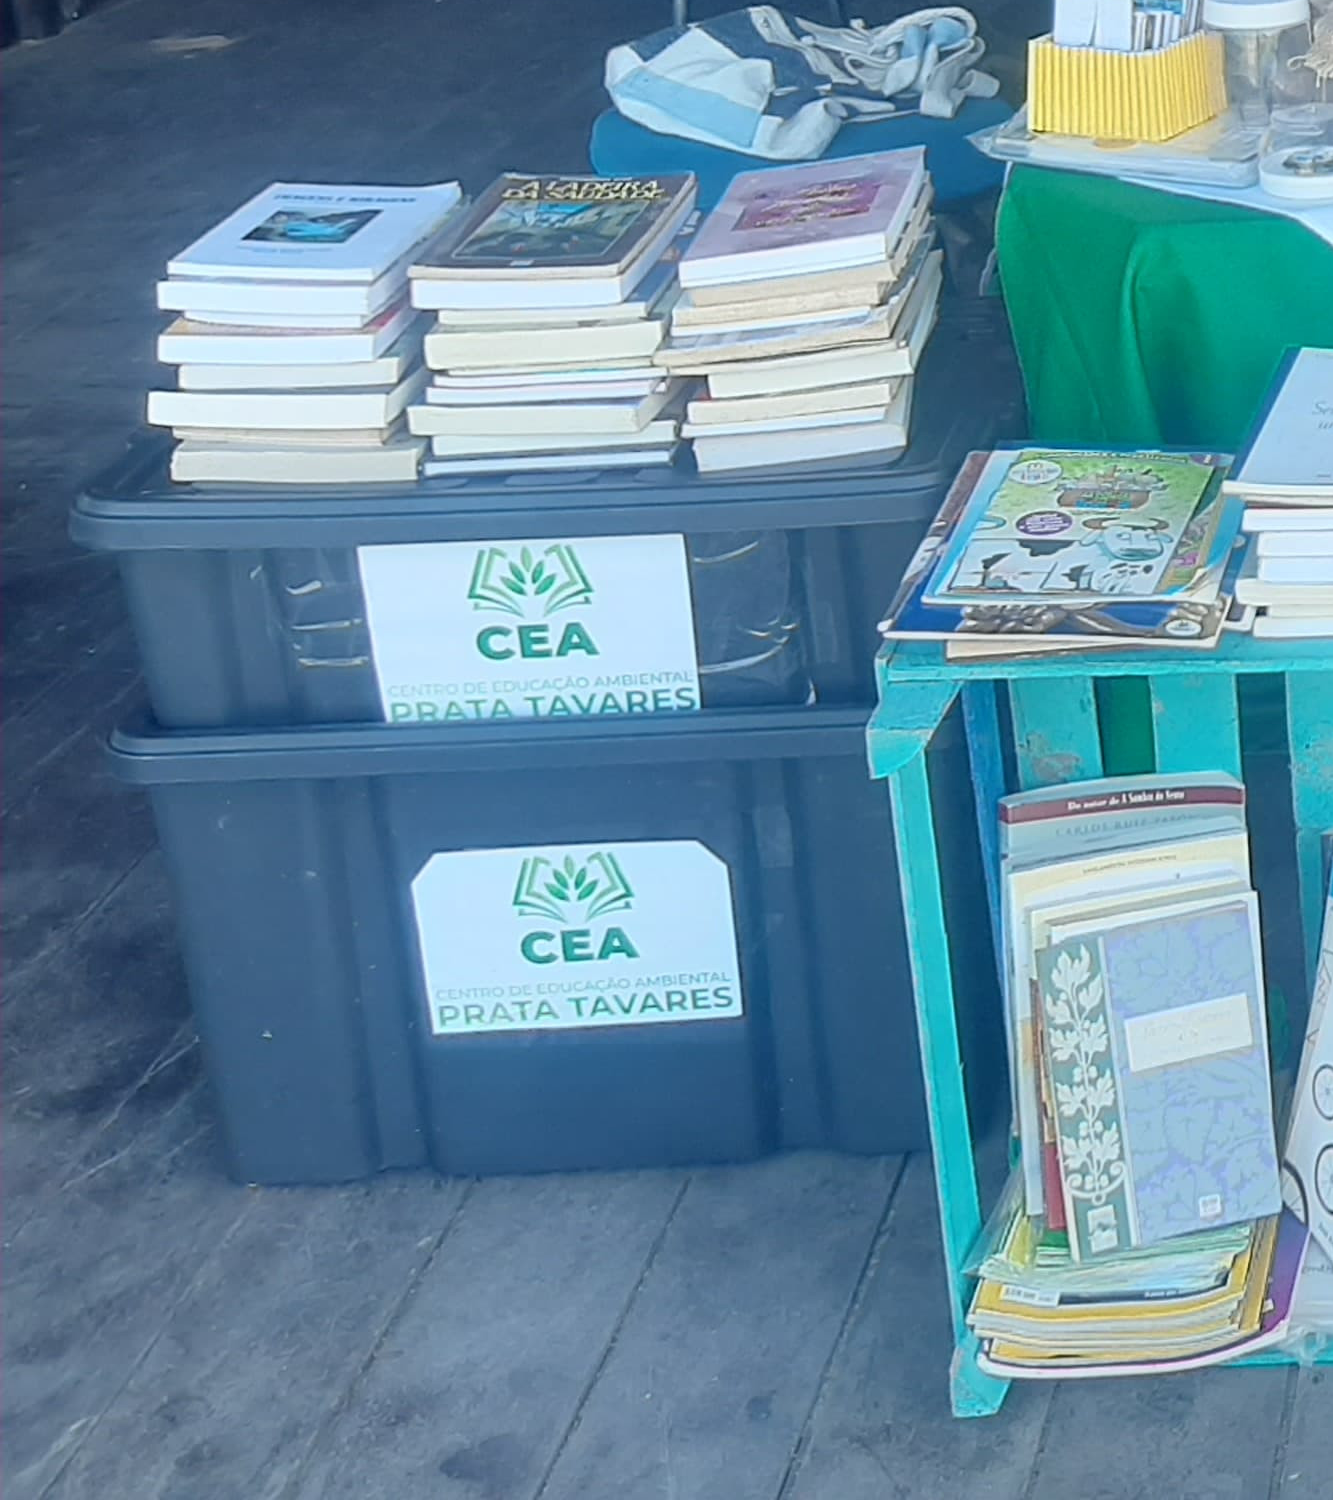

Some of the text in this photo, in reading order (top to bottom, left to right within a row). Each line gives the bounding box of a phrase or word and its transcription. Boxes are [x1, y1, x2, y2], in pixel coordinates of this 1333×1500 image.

[476, 621, 600, 661] CEA
[388, 670, 694, 698] CENTRO DE EDUCAÇÃO AMBIENTAL
[390, 686, 697, 724] PRATA TAVARES
[1067, 800, 1082, 811] Do
[1083, 799, 1107, 809] autor
[1109, 797, 1120, 806] de
[1121, 793, 1128, 804] A
[1055, 821, 1108, 837] CARLOS
[519, 927, 641, 965] CEA
[435, 970, 733, 1001] CENTRO DE EDUCAÇÃO AMBIENTAL
[438, 986, 735, 1028] PRATA TAVARES
